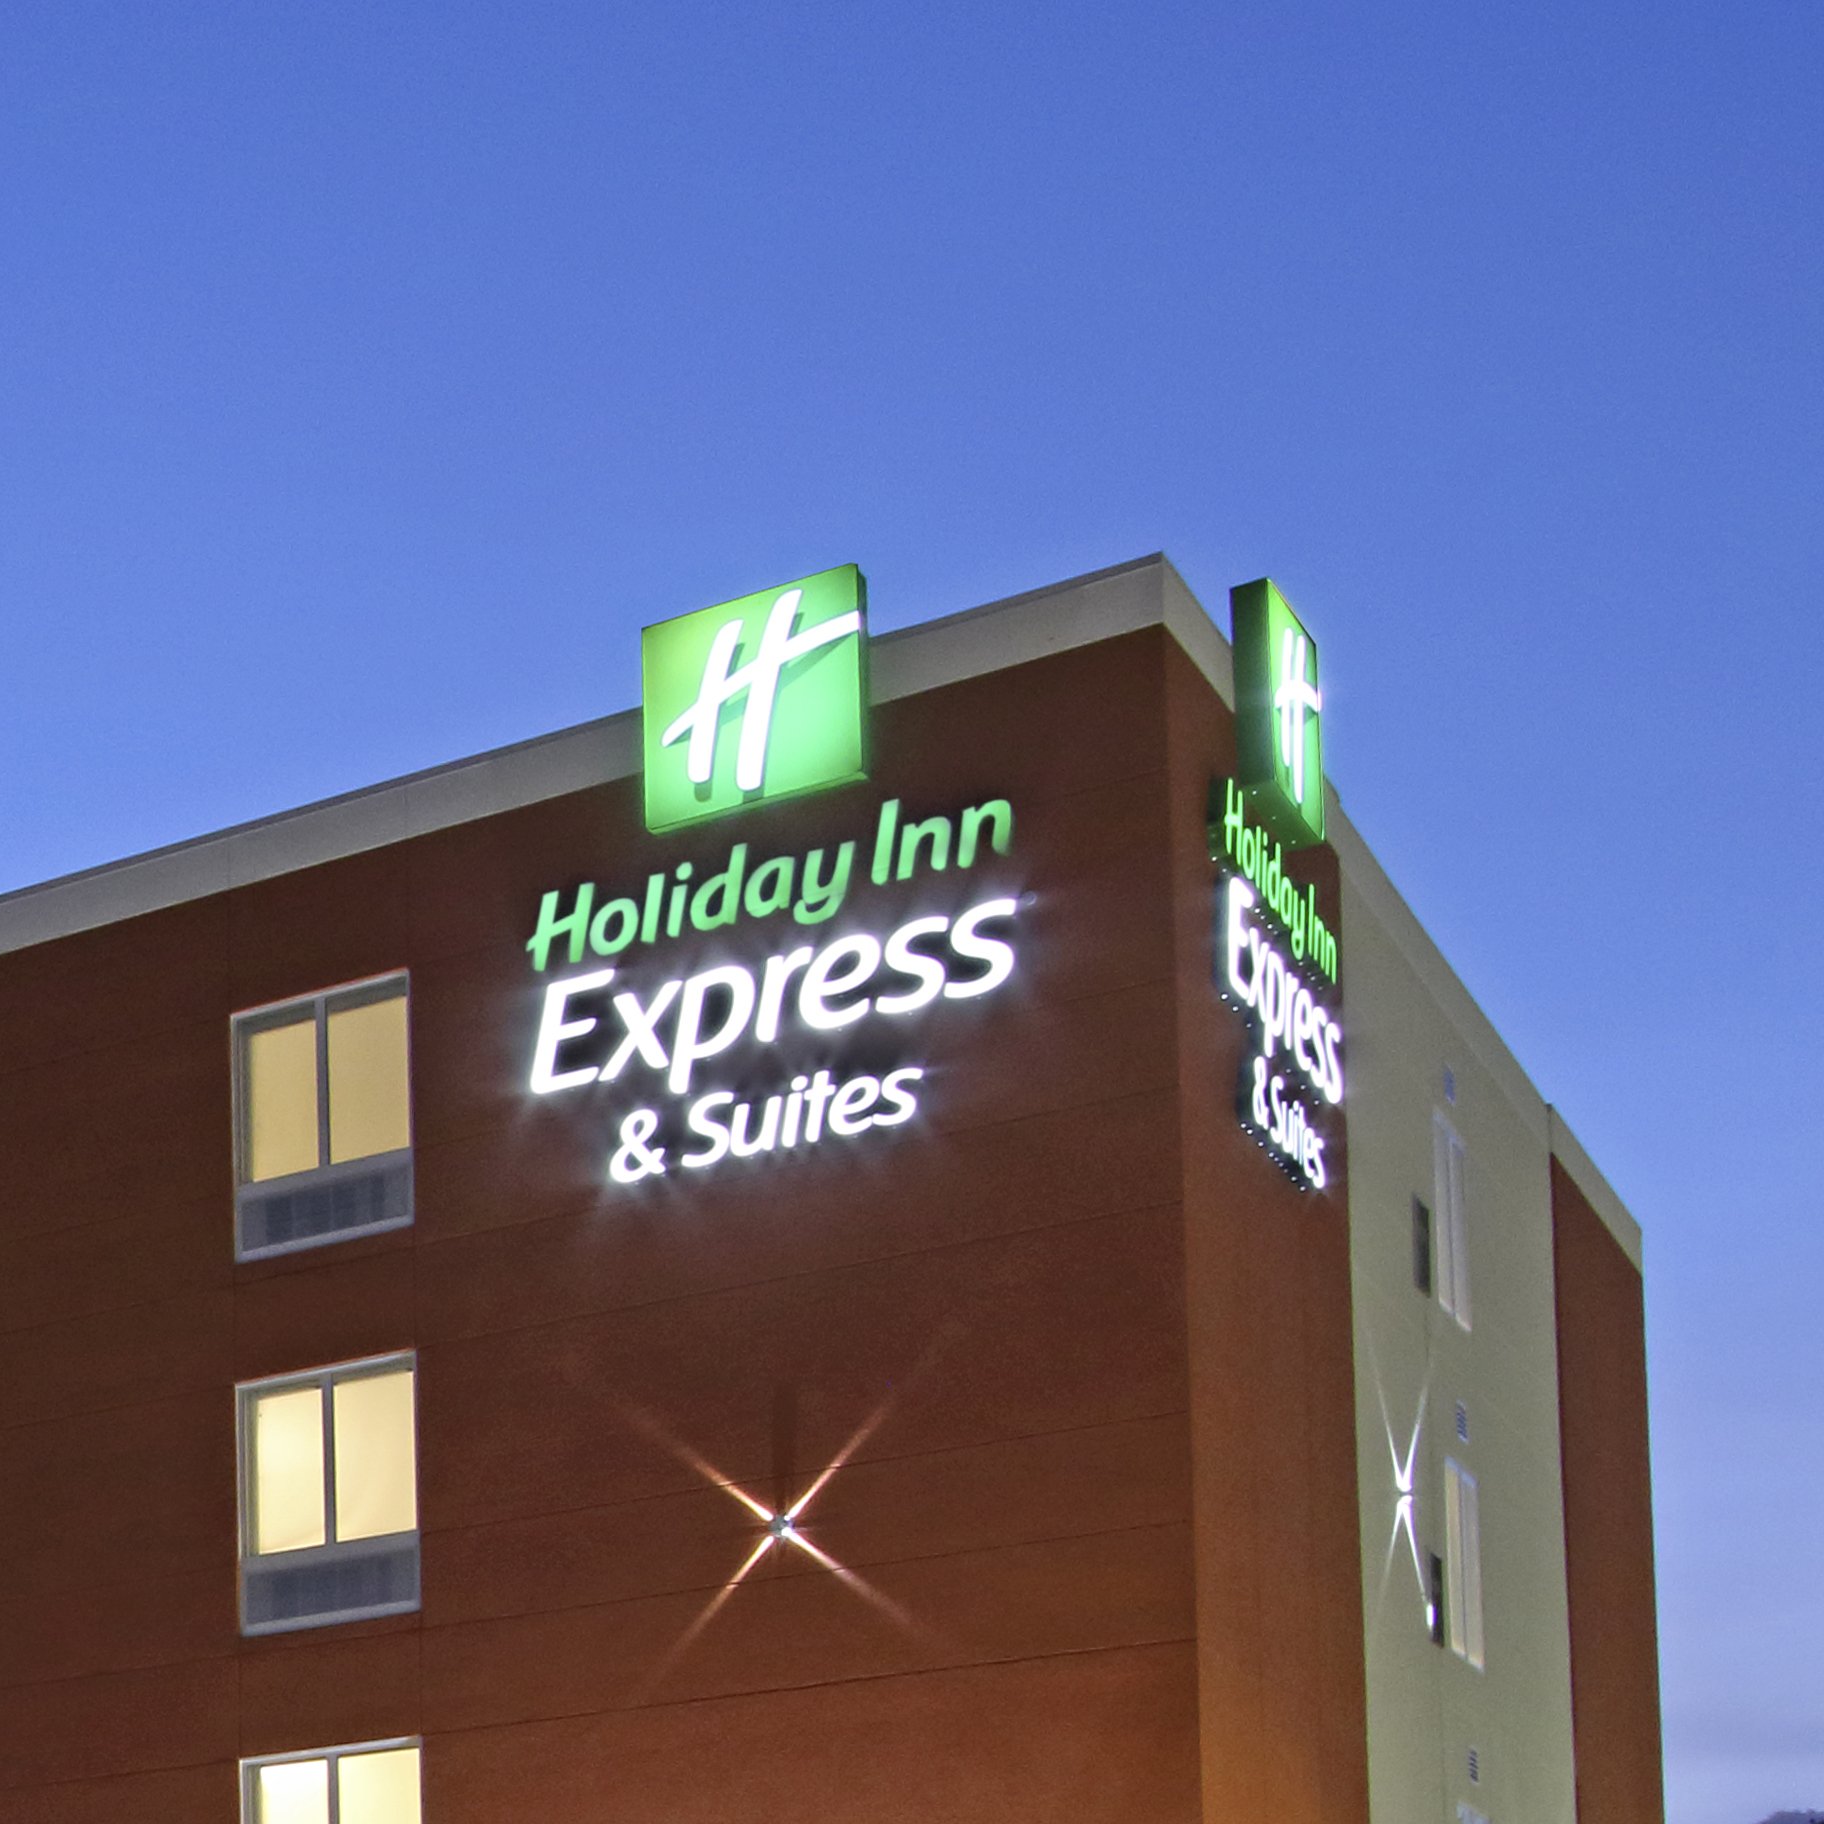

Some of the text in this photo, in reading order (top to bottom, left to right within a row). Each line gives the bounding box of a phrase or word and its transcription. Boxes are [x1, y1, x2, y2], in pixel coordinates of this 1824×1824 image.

[661, 589, 862, 791] H
[1275, 628, 1322, 803] H
[525, 798, 1013, 971] Holiday Inn
[1224, 778, 1337, 985] Holiday Inn
[530, 898, 1018, 1095] Express
[1228, 876, 1342, 1104] Express
[608, 1067, 925, 1183] & Suites
[1253, 1055, 1326, 1188] & Suites
